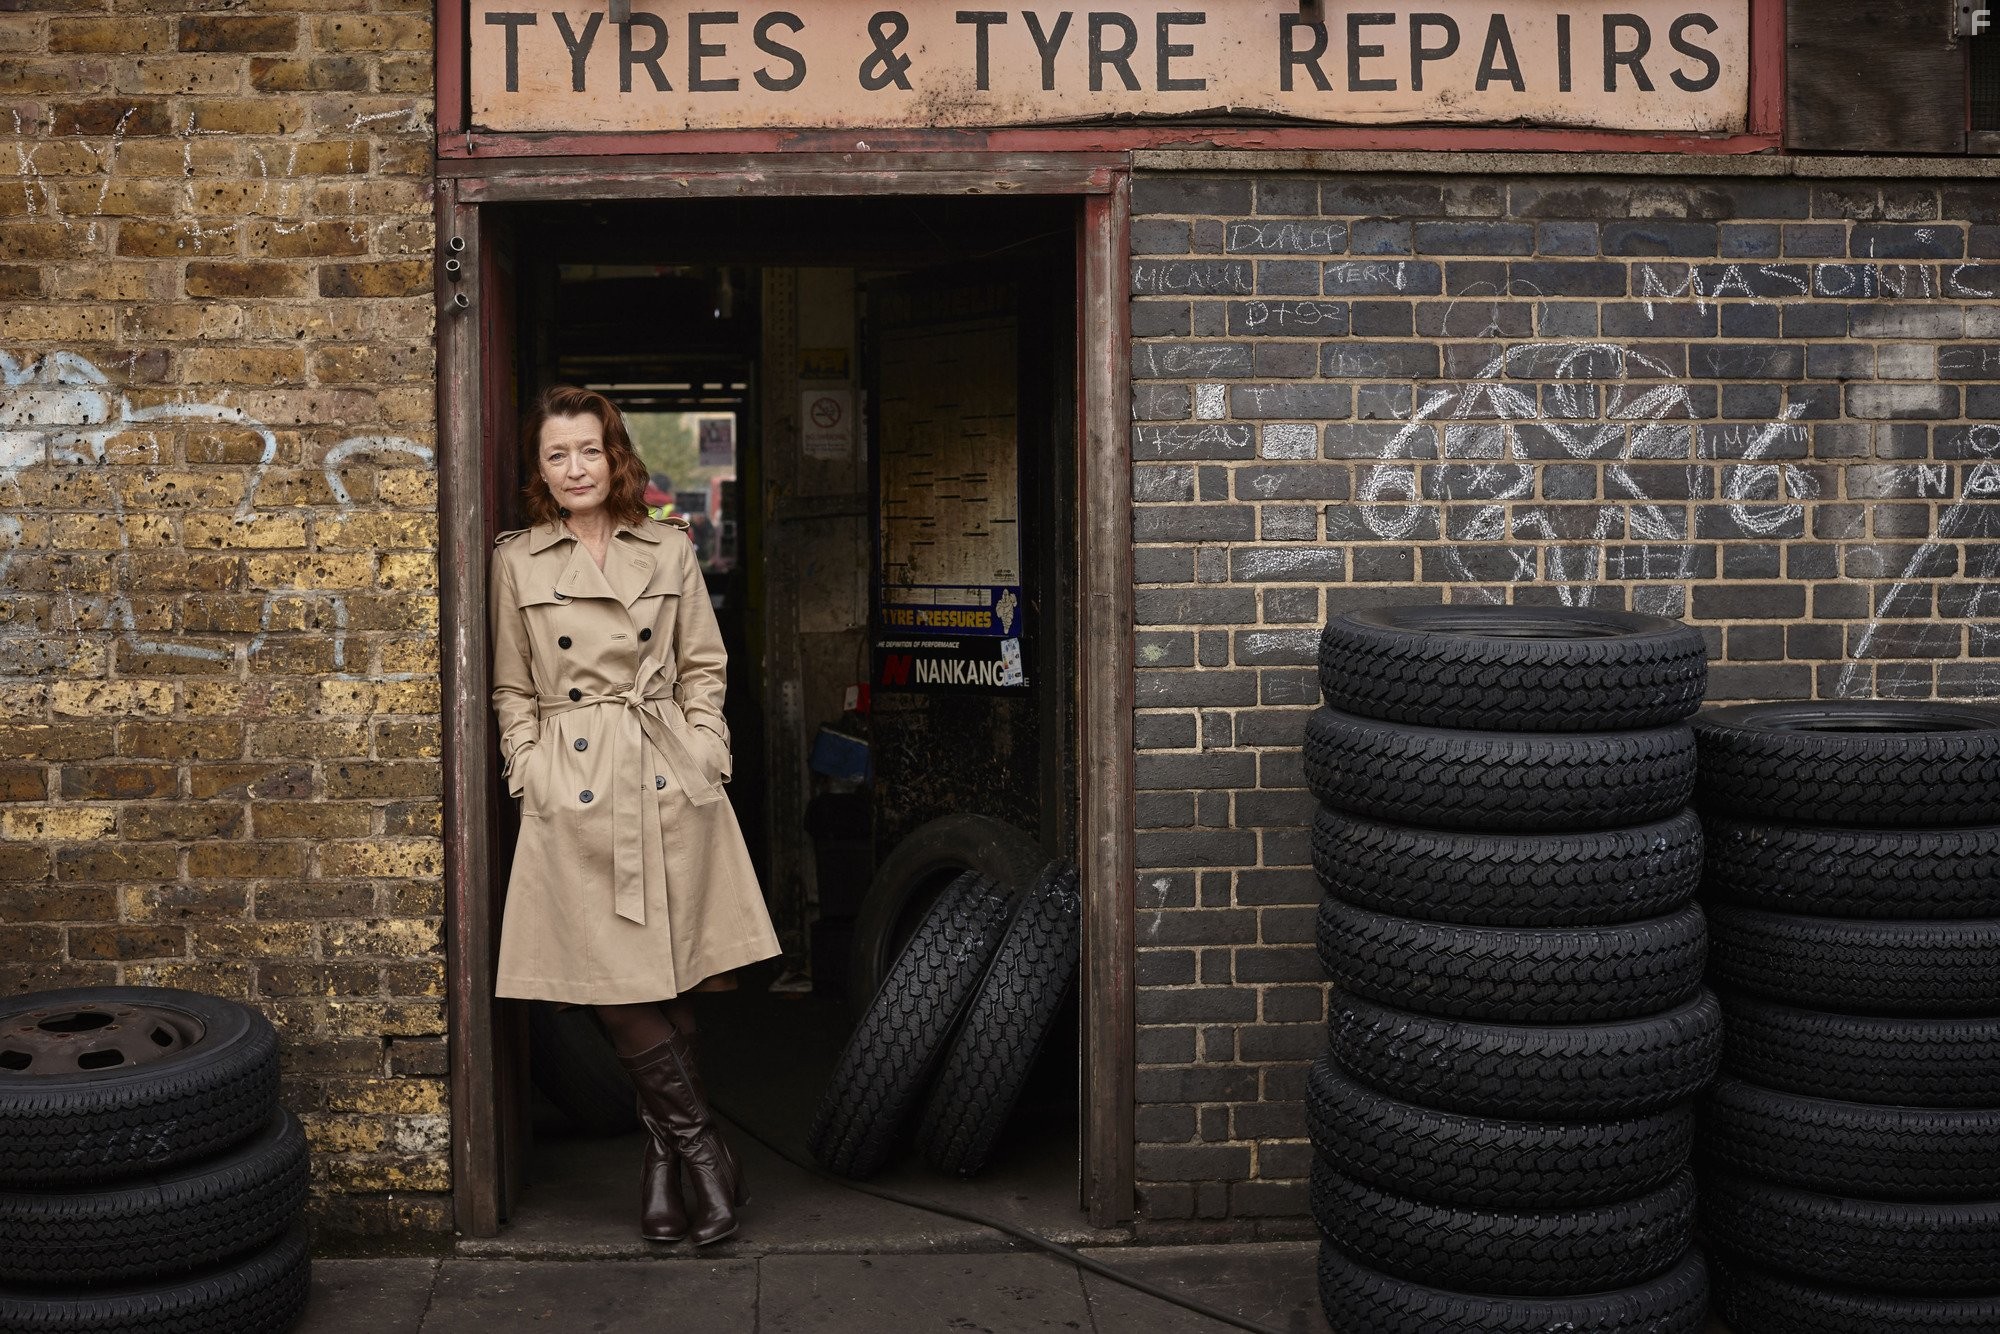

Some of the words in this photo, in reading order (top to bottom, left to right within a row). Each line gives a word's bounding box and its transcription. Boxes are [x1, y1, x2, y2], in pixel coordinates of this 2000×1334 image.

[484, 11, 808, 92] TYRES
[857, 11, 913, 92] &
[956, 11, 1207, 92] TYRE
[1279, 13, 1721, 93] REPAIRS
[882, 609, 914, 626] TYRE
[916, 610, 992, 628] PRESSURES
[921, 641, 960, 649] PERFORMANCE
[916, 658, 1004, 687] NANKANG
